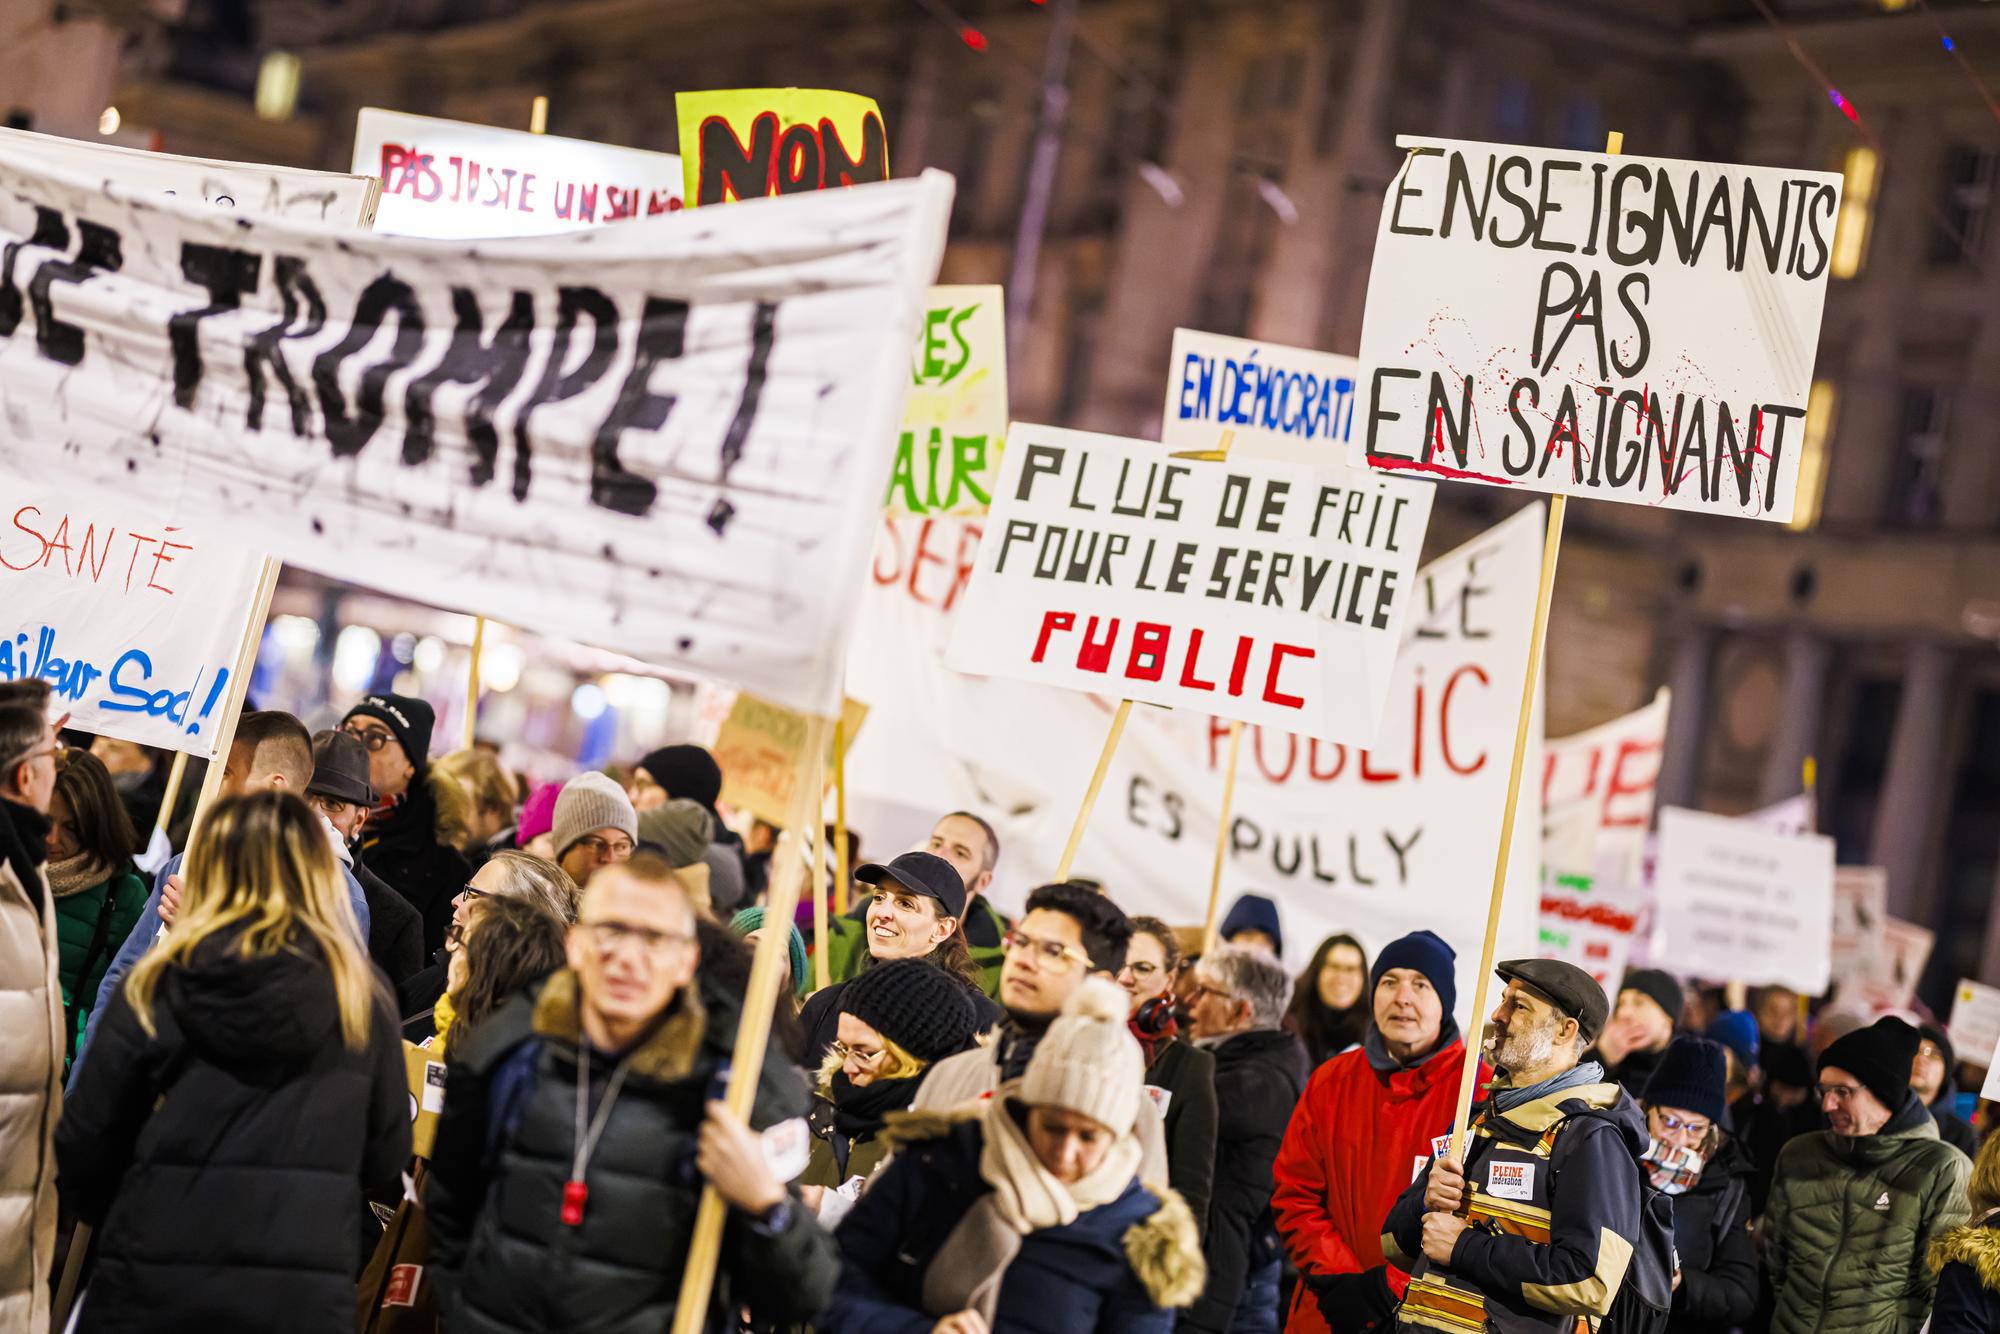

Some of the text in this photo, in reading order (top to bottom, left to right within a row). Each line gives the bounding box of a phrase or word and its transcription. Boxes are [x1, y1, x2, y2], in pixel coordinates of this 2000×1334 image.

[381, 144, 443, 202] PAS
[449, 156, 536, 212] JUSTE
[554, 181, 598, 223] UN
[698, 111, 888, 207] NON
[1390, 147, 1836, 281] ENSEIGNANTS
[912, 303, 982, 386] ES
[1532, 261, 1650, 380] PAS
[1179, 353, 1215, 420] EN
[1366, 367, 1807, 512] EN SAIGNANT
[1014, 444, 1191, 522] PLUS
[1216, 474, 1291, 532] DE
[0, 506, 194, 597] SANTÉ
[995, 519, 1398, 630] POUR LE SERVICE
[1030, 611, 1316, 710] PUBLIC
[1230, 814, 1424, 886] PULLY
[1493, 1165, 1524, 1178] PLEINE
